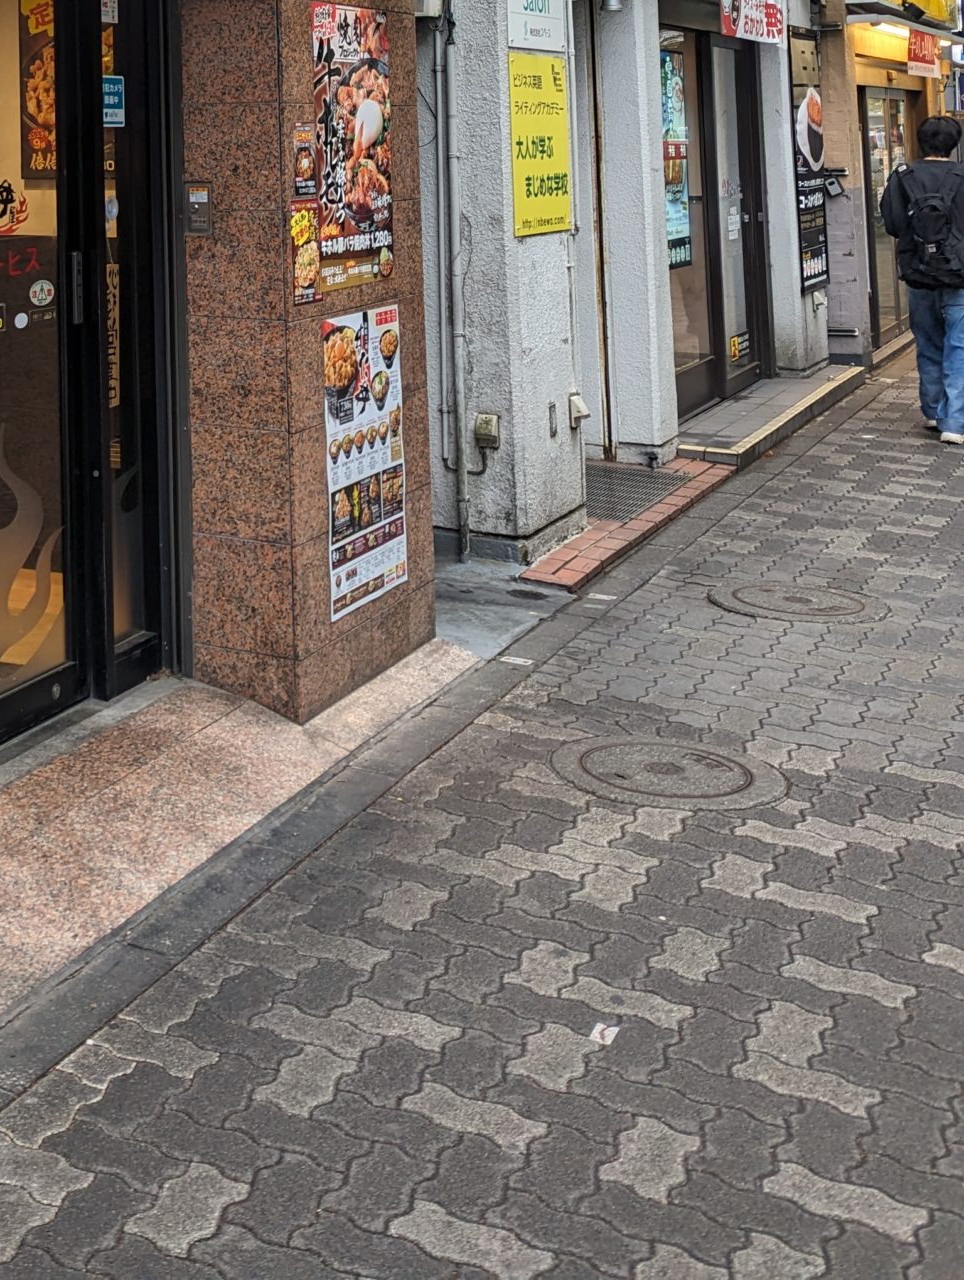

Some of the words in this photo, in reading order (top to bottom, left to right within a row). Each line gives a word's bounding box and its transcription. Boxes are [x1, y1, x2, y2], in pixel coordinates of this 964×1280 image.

[513, 74, 543, 90] ビジネス英語
[514, 100, 564, 116] ライティングアカデミー
[515, 135, 554, 161] 大人が学ぶ
[525, 172, 568, 199] まじめな学校
